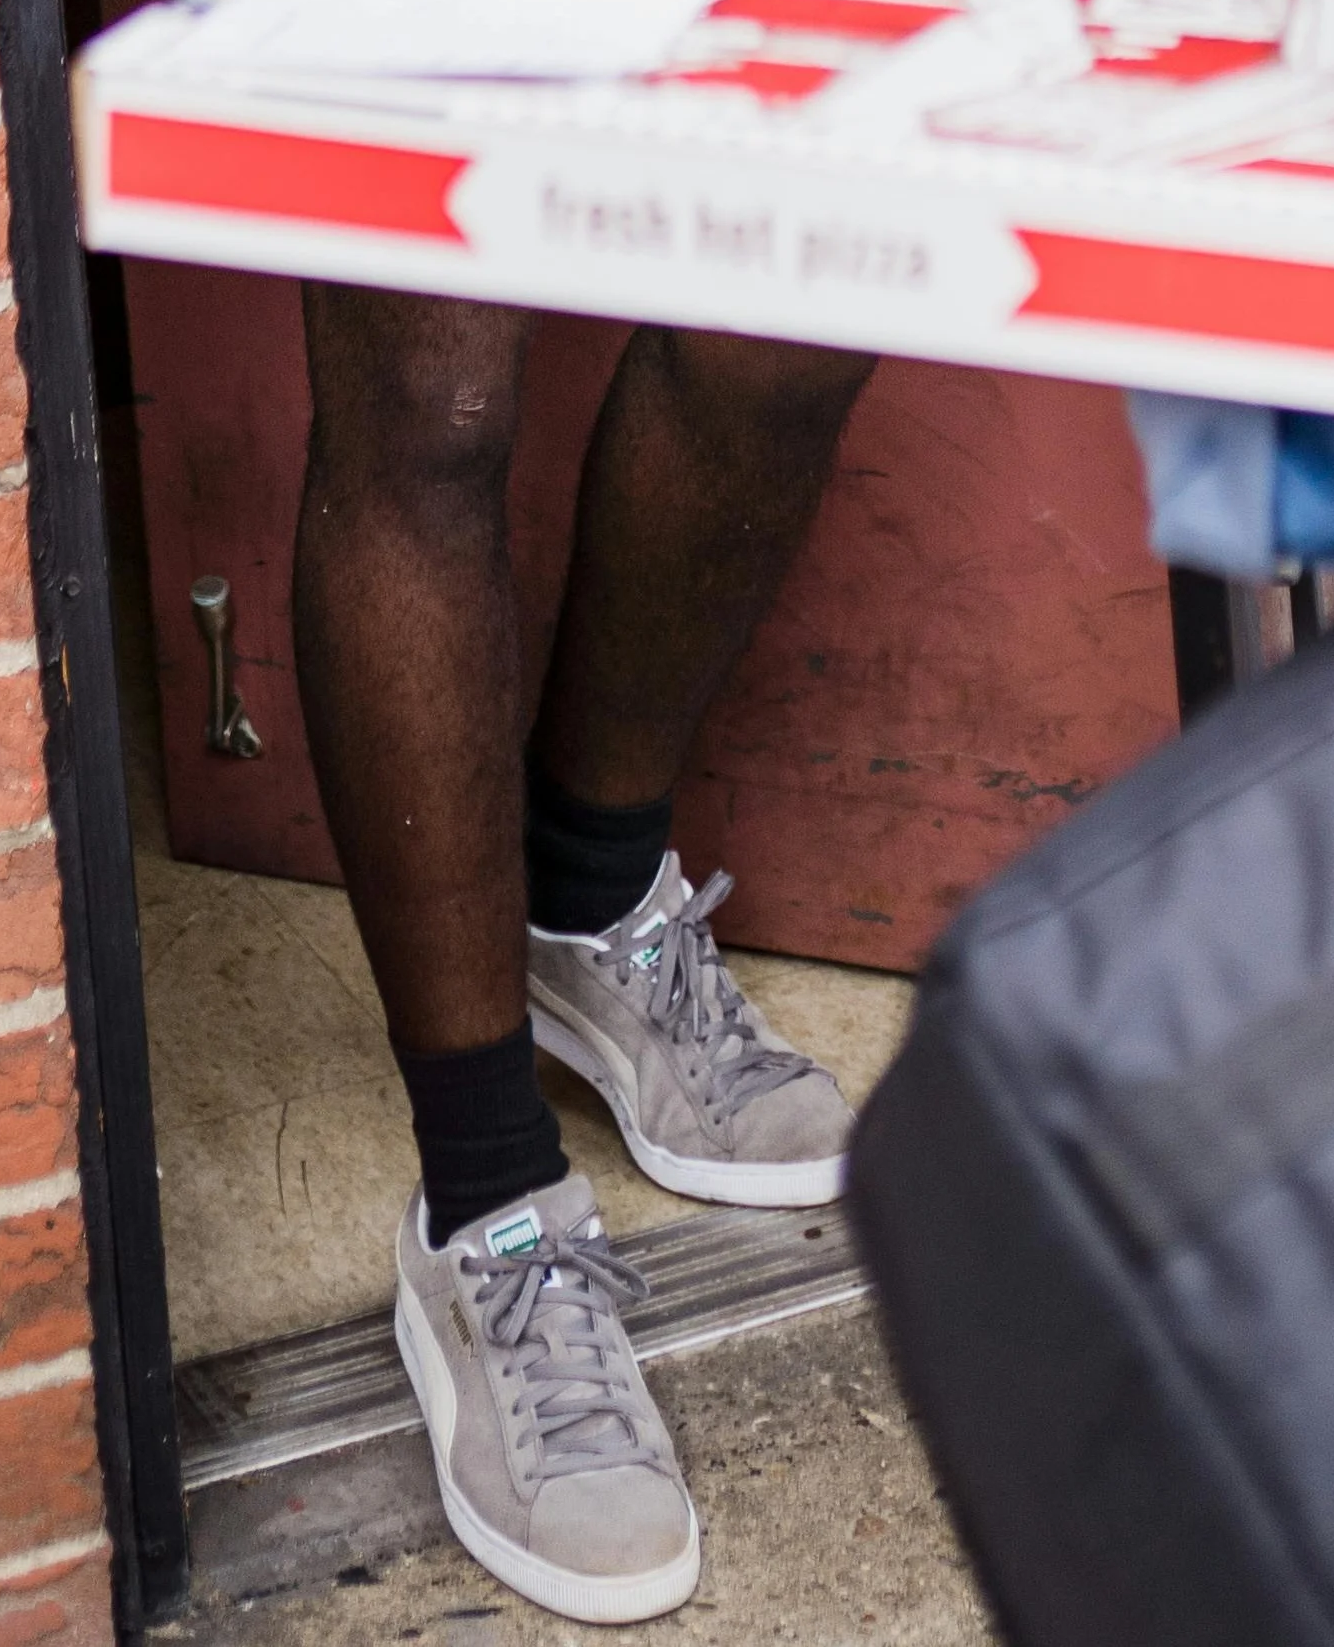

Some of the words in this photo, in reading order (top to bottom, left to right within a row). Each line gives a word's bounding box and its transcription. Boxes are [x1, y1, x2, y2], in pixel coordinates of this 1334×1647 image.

[539, 177, 670, 255] fresh
[695, 195, 773, 273] hot
[798, 218, 931, 293] pizza
[494, 1221, 536, 1256] PUMA
[449, 1299, 472, 1347] PUMA
